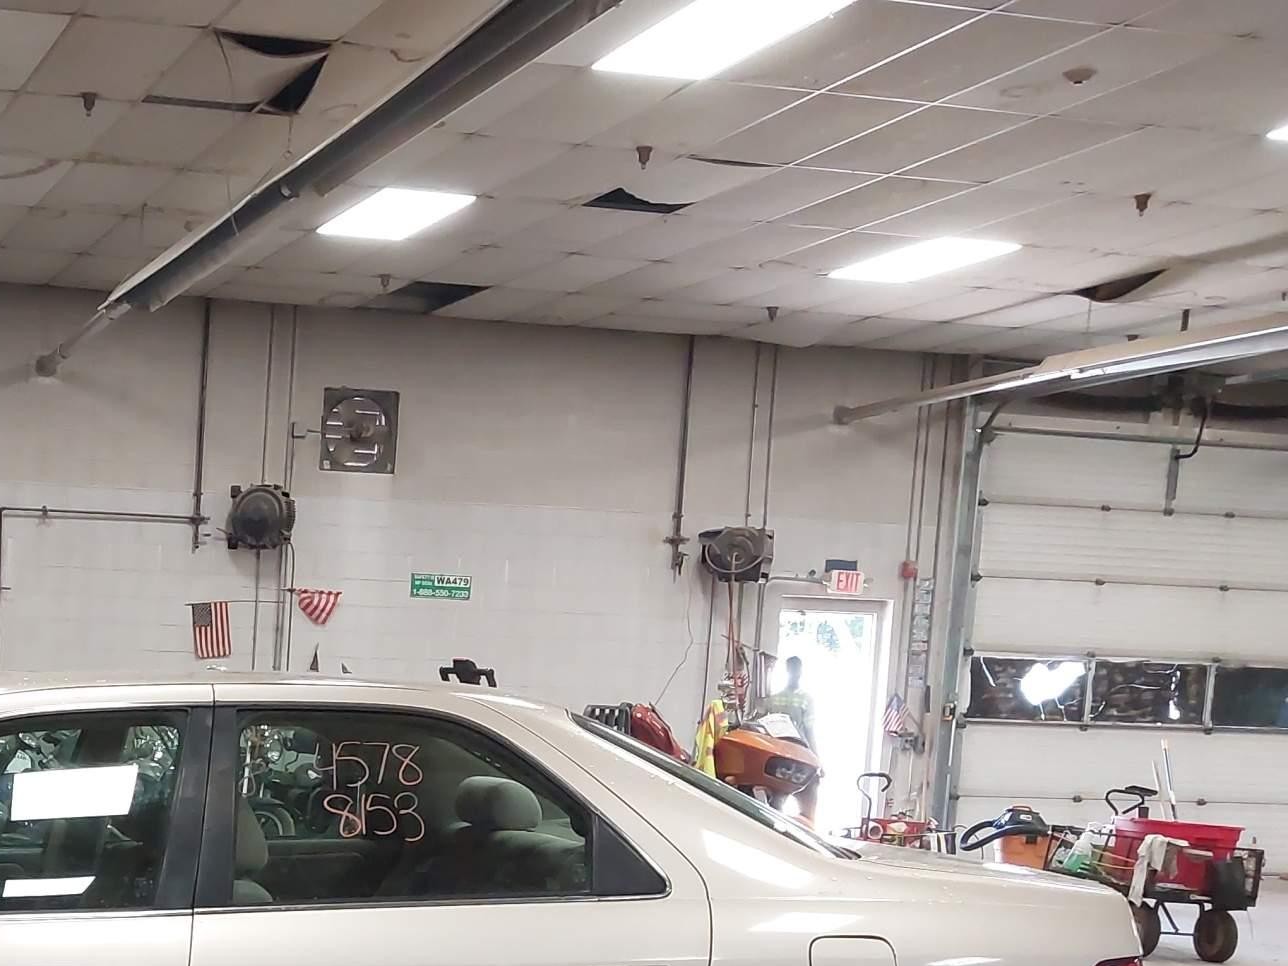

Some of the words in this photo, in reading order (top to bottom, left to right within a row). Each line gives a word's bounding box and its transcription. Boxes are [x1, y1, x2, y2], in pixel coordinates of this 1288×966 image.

[436, 576, 469, 586] WA479
[837, 571, 861, 592] EXIT
[313, 741, 423, 791] 4578
[323, 792, 425, 842] 8153
